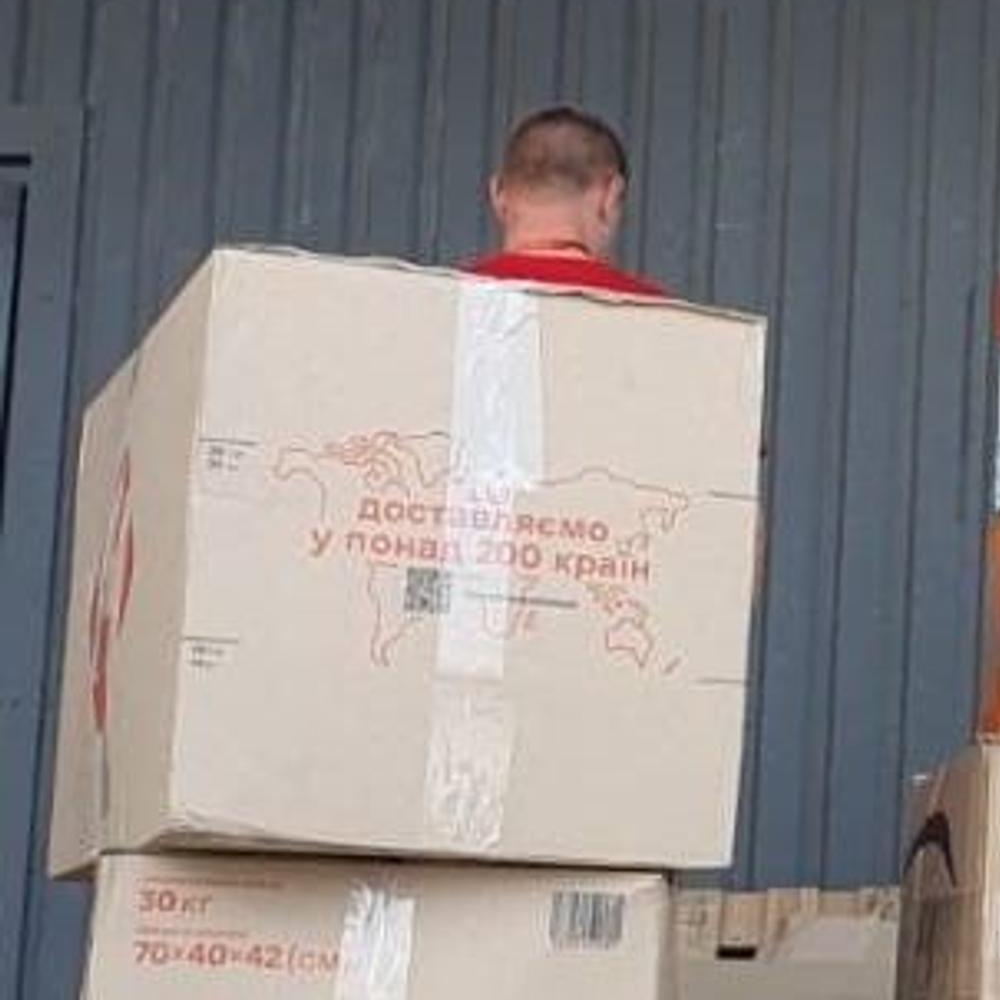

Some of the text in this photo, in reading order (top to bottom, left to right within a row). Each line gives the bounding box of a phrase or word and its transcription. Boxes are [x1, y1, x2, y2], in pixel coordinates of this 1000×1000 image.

[476, 540, 542, 569] 200
[136, 889, 213, 915] 30 кг
